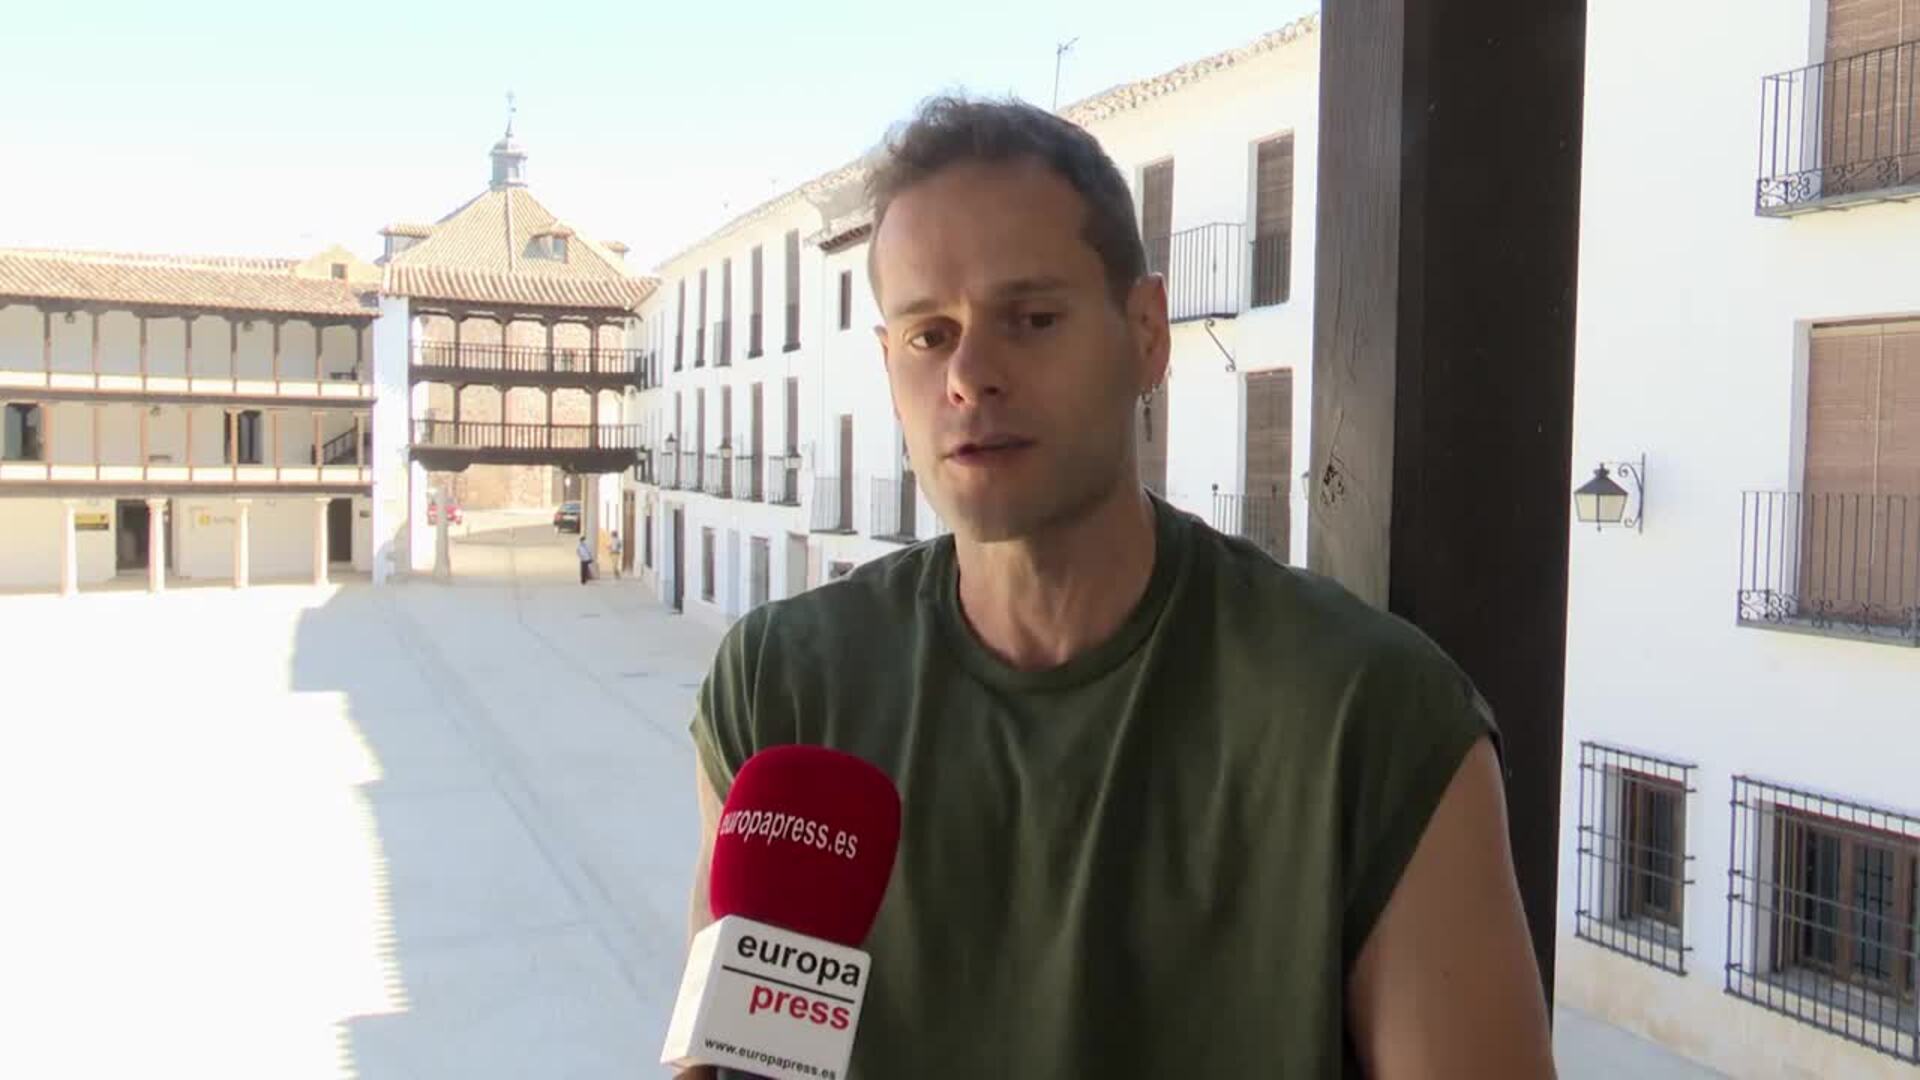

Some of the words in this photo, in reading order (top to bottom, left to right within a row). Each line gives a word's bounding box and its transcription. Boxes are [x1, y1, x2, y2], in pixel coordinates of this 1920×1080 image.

[720, 809, 858, 859] europapress.es
[737, 935, 861, 987] europa
[749, 985, 850, 1030] press
[704, 1038, 837, 1080] www.europapress.es
